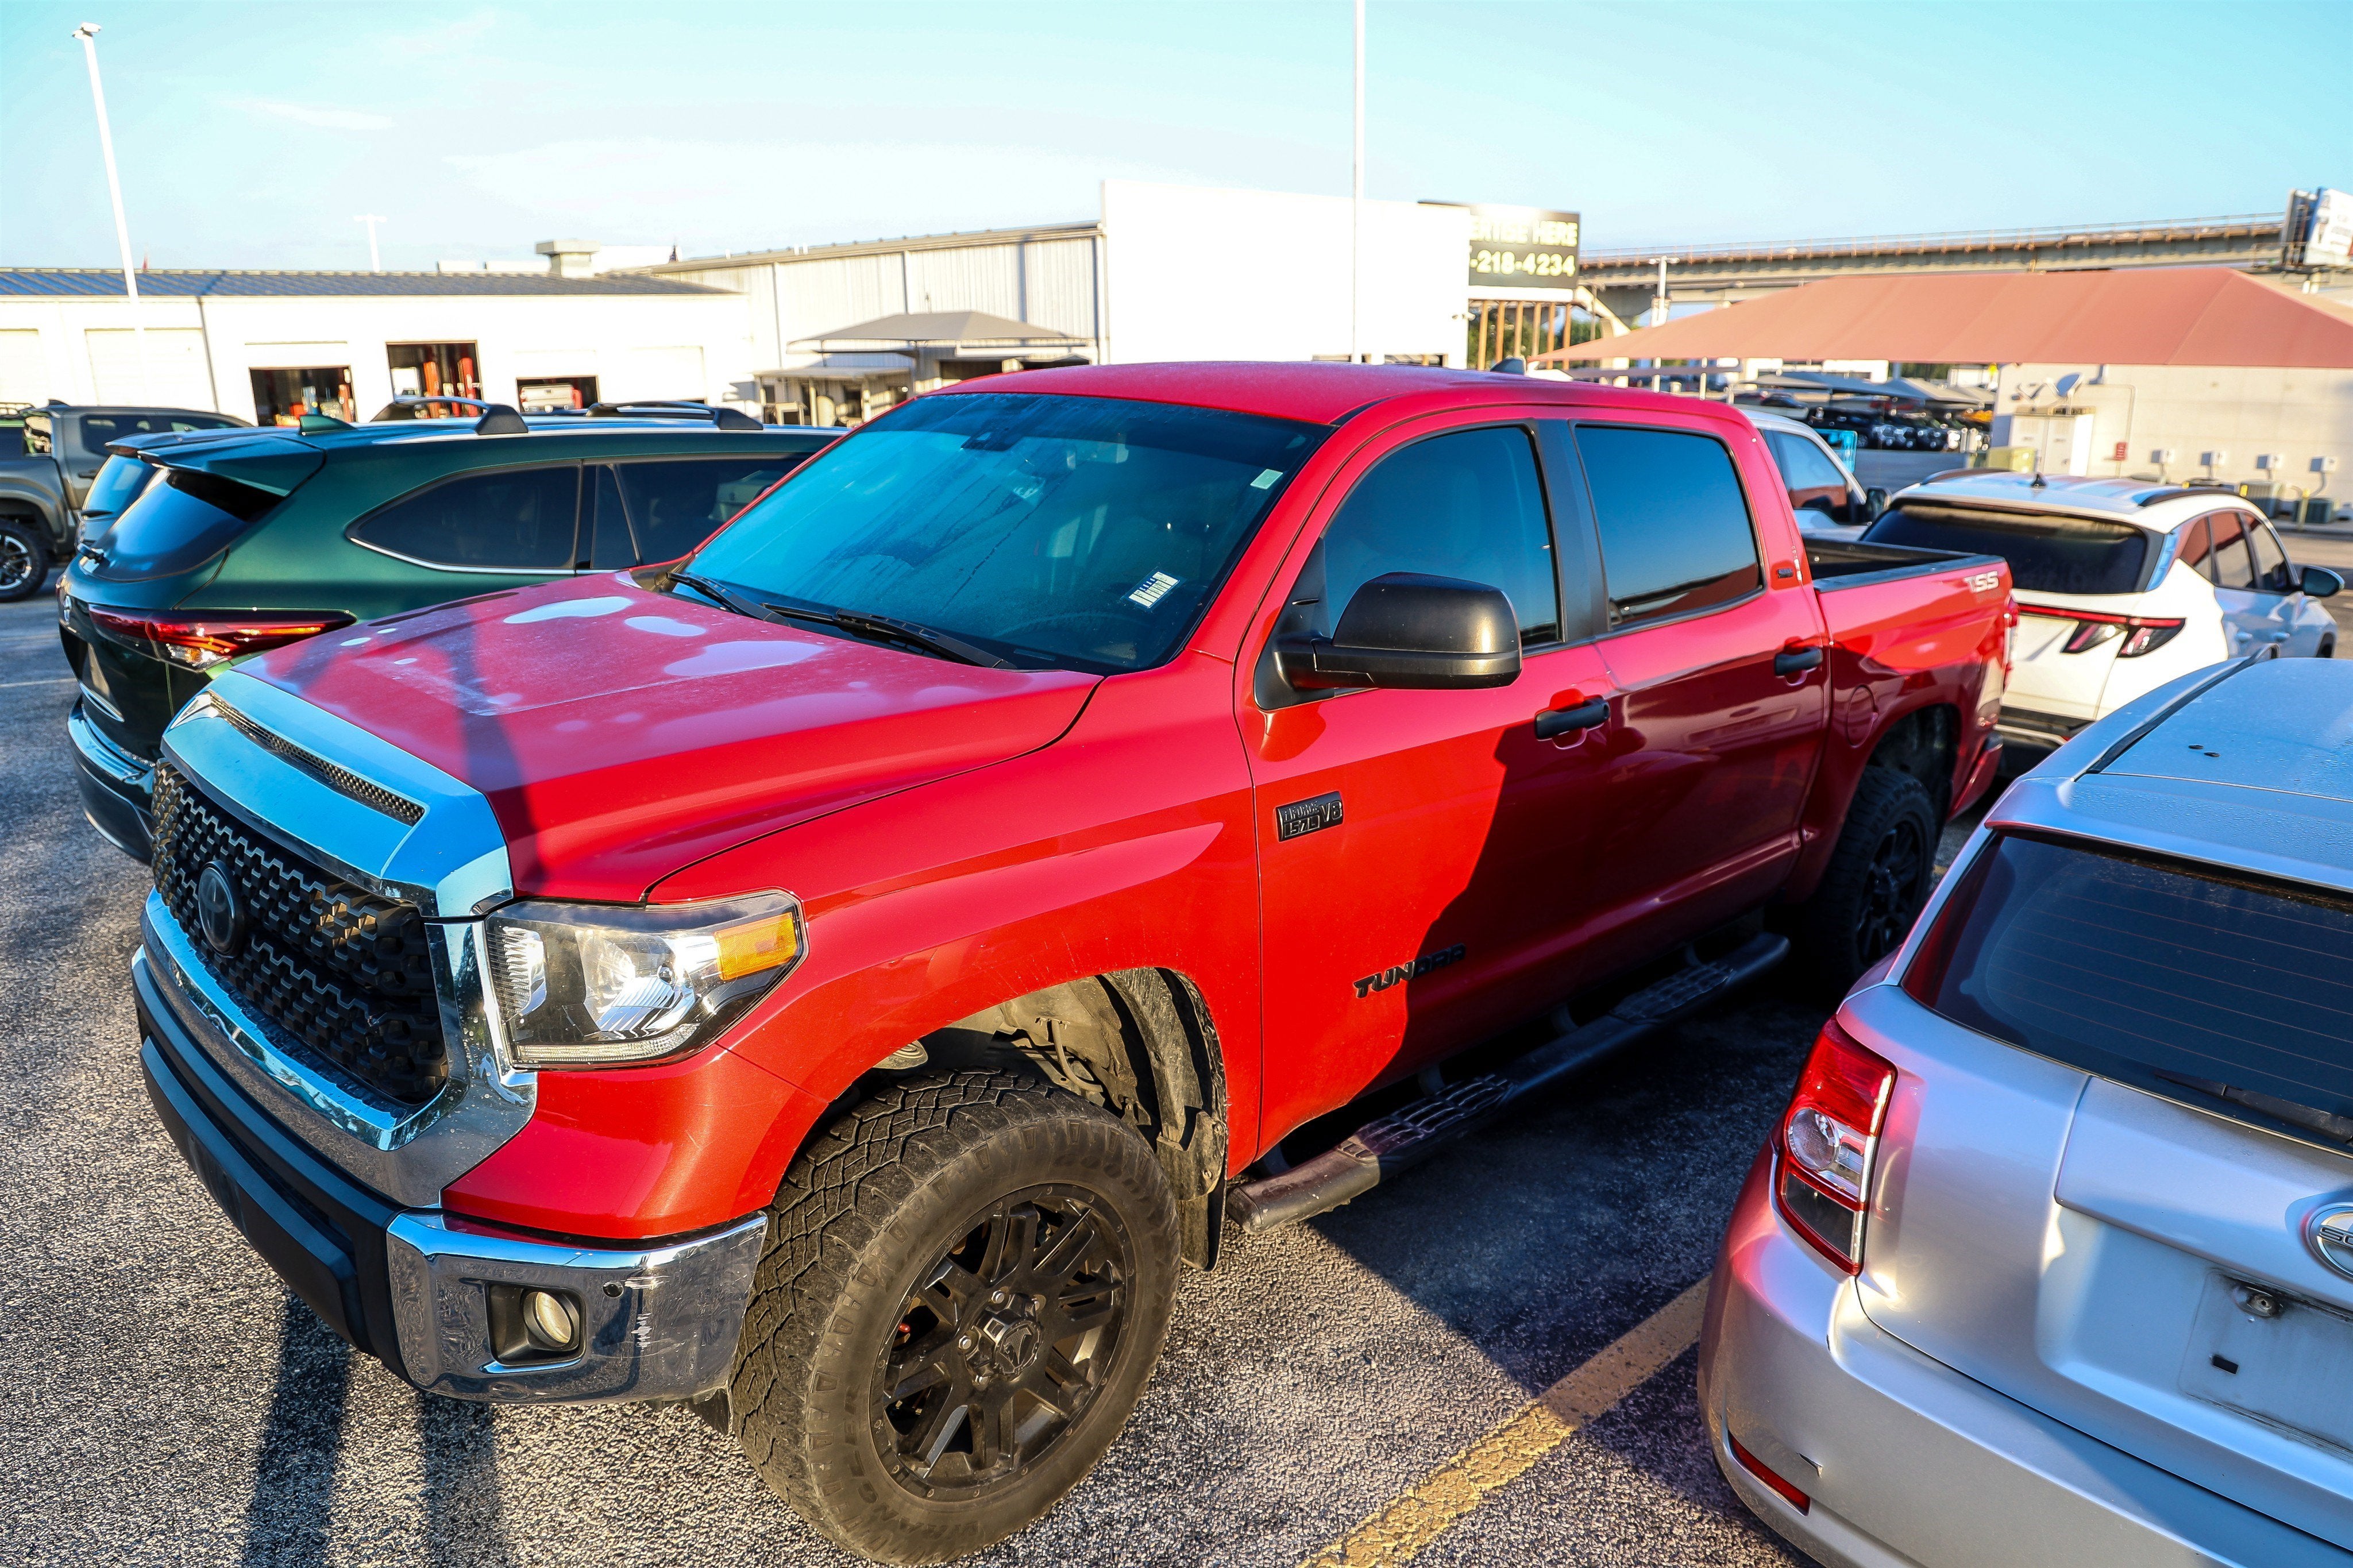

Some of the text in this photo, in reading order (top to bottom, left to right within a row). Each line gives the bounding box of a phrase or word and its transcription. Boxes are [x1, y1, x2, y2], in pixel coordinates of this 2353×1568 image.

[1532, 221, 1578, 247] HERE
[1469, 249, 1576, 277] -218-4234
[1963, 570, 1999, 593] TSS
[1320, 800, 1343, 822] V8
[1353, 943, 1466, 999] TUNDRA
